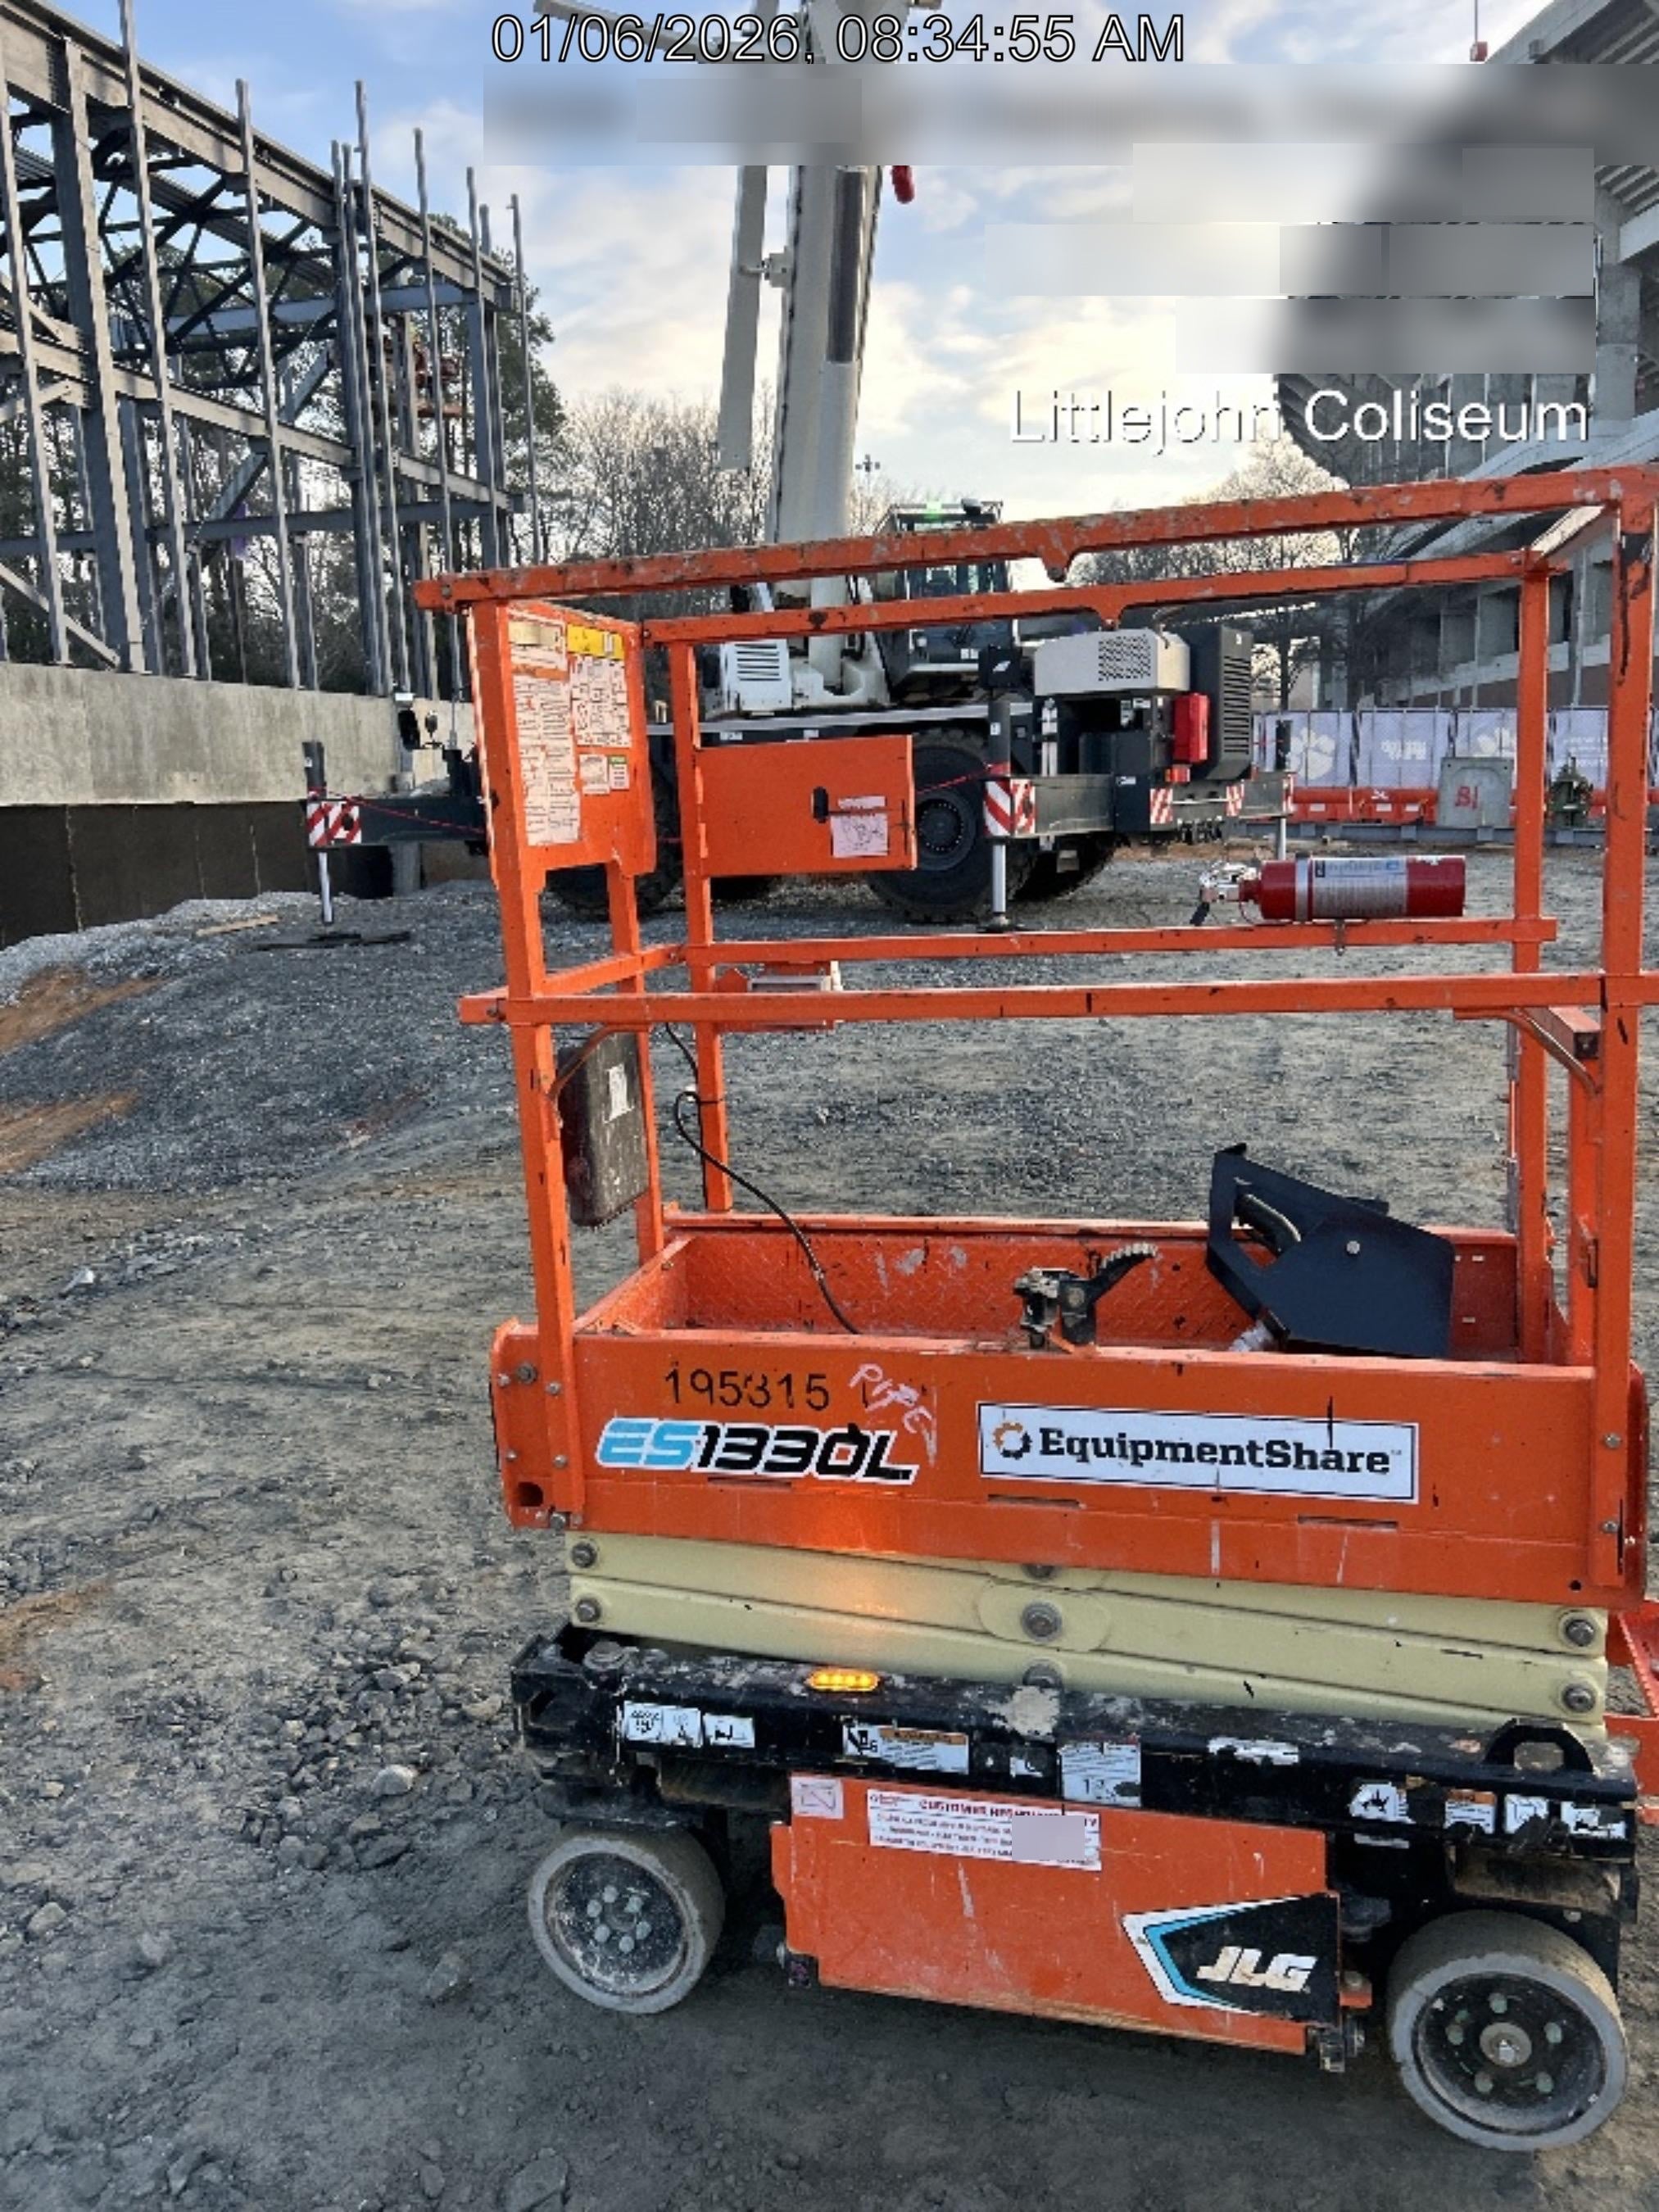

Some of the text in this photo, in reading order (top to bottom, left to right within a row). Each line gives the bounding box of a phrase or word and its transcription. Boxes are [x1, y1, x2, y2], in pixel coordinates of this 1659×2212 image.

[664, 1362, 830, 1412] 195315
[596, 1418, 918, 1483] ES1330L
[1039, 1426, 1390, 1475] EquipmentShare
[1195, 1945, 1318, 1993] JLG
